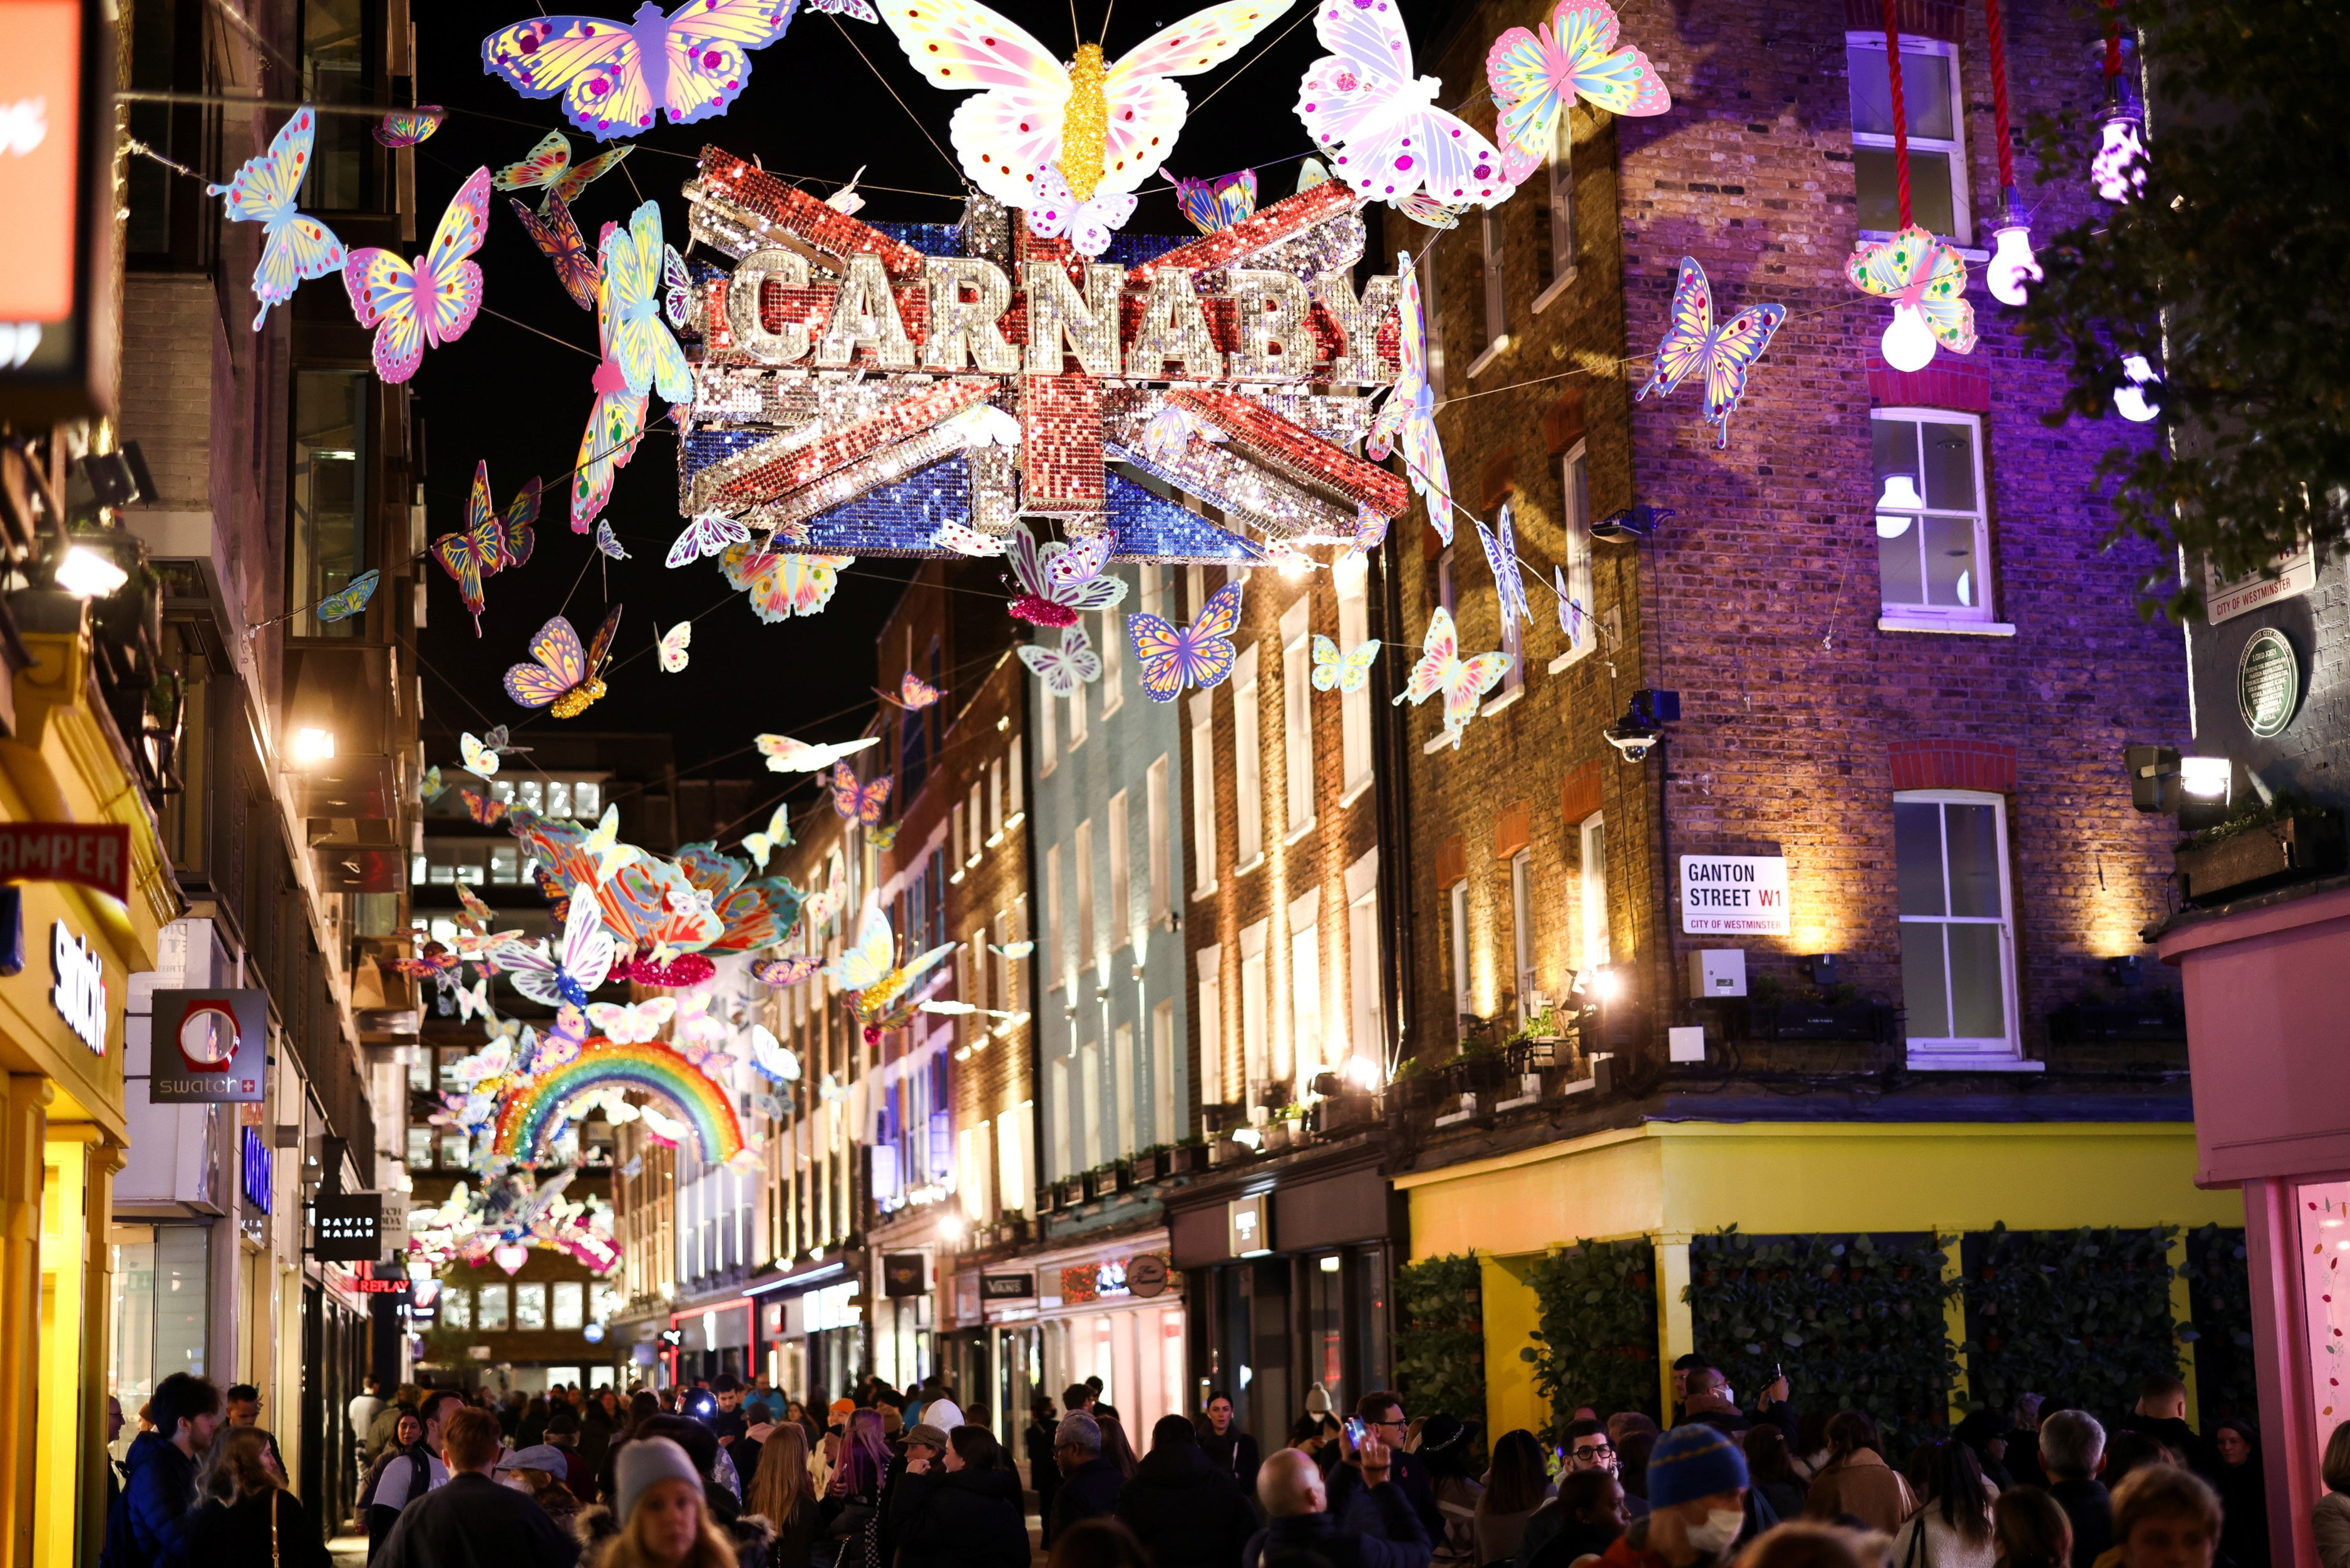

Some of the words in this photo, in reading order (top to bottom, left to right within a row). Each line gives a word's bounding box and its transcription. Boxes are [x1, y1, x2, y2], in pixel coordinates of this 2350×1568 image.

[724, 249, 1403, 387] CARNABY
[2217, 601, 2230, 616] CITY
[2232, 597, 2240, 610] OF
[2242, 577, 2291, 606] WESTMINSTER
[2252, 651, 2265, 662] LORD
[2265, 647, 2277, 658] JOHN
[0, 832, 120, 886] AMPER
[1688, 863, 1755, 882] GANTON
[1690, 888, 1751, 906] STREET
[1758, 889, 1781, 907] W1
[1691, 919, 1708, 929] CITY
[1711, 920, 1721, 929] OF
[1724, 920, 1781, 929] WESTMINSTER
[160, 1077, 240, 1093] swatch
[245, 1126, 272, 1215] OFFICE
[322, 1217, 374, 1227] DAVID
[322, 1229, 374, 1239] NAMAN
[360, 1280, 411, 1292] REPLAY
[987, 1279, 1023, 1293] VANS
